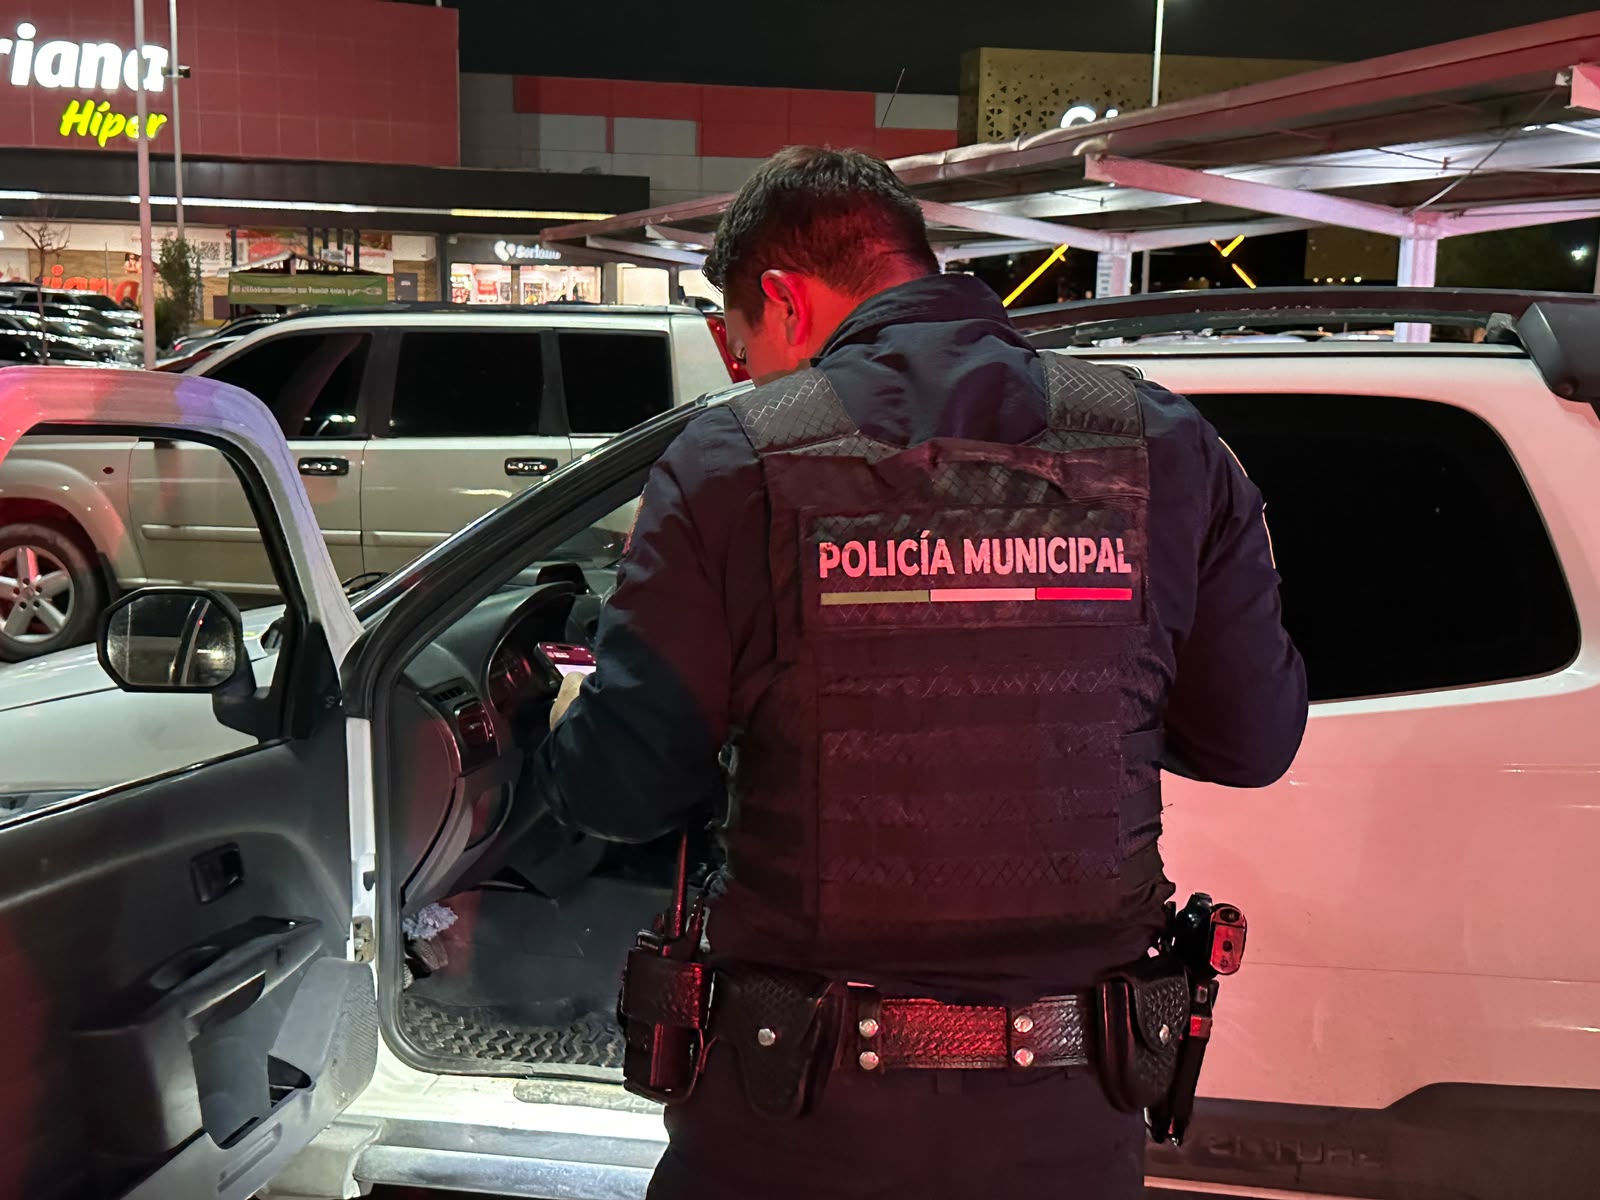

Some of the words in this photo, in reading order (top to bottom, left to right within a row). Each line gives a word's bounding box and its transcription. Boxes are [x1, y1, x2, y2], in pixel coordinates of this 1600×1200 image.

[59, 99, 168, 148] Híper
[819, 529, 955, 578] POLICÍA
[963, 536, 1133, 575] MUNICIPAL
